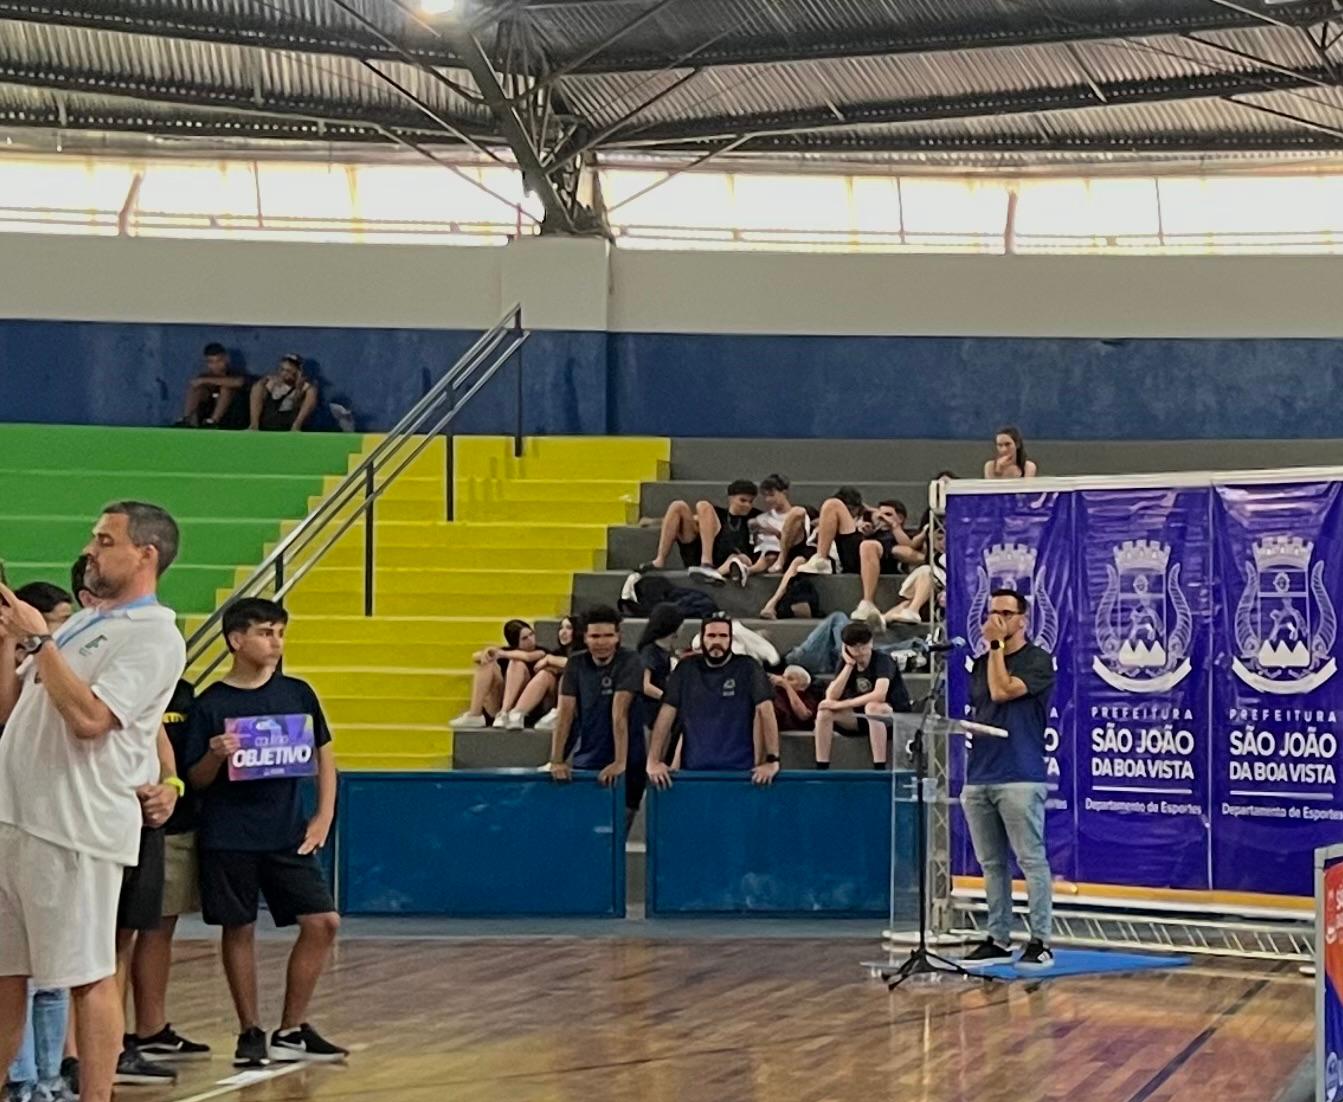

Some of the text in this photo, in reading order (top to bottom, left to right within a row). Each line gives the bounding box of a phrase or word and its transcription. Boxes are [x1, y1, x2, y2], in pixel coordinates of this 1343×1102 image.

[1092, 706, 1193, 720] PREFEITURA
[1229, 708, 1336, 722] PREFEITURA
[1092, 722, 1133, 753] SÃO
[1136, 724, 1194, 755] JOÃO
[1230, 724, 1337, 758] SÃO JOÃO
[232, 744, 311, 768] OBJETIVO
[1092, 757, 1194, 779] DA BOA VISTA
[1229, 761, 1336, 784] DA BOA VISTA
[1303, 806, 1343, 821] Esportes
